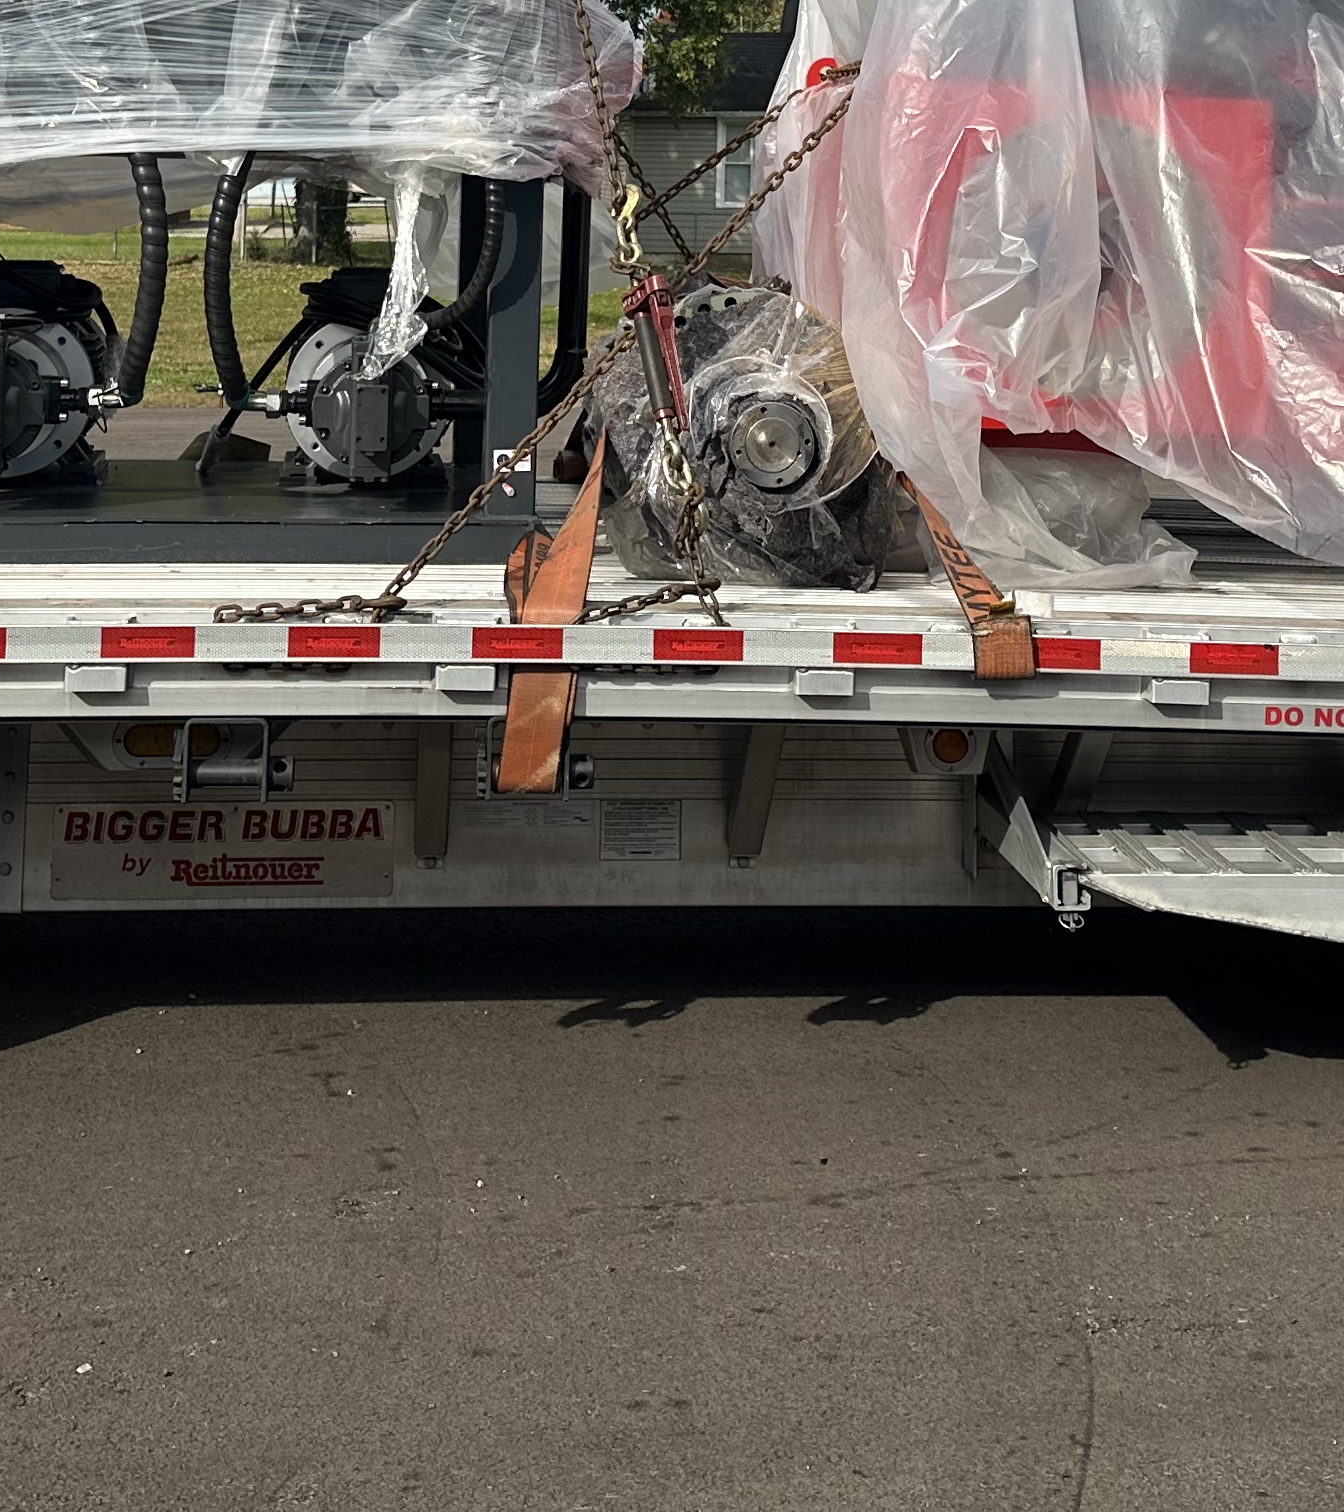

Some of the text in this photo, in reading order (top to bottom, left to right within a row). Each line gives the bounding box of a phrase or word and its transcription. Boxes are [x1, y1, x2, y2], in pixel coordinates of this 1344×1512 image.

[1264, 707, 1304, 726] DO
[64, 807, 384, 843] BIGGER BUBBA
[121, 853, 325, 887] by Reitnouer
